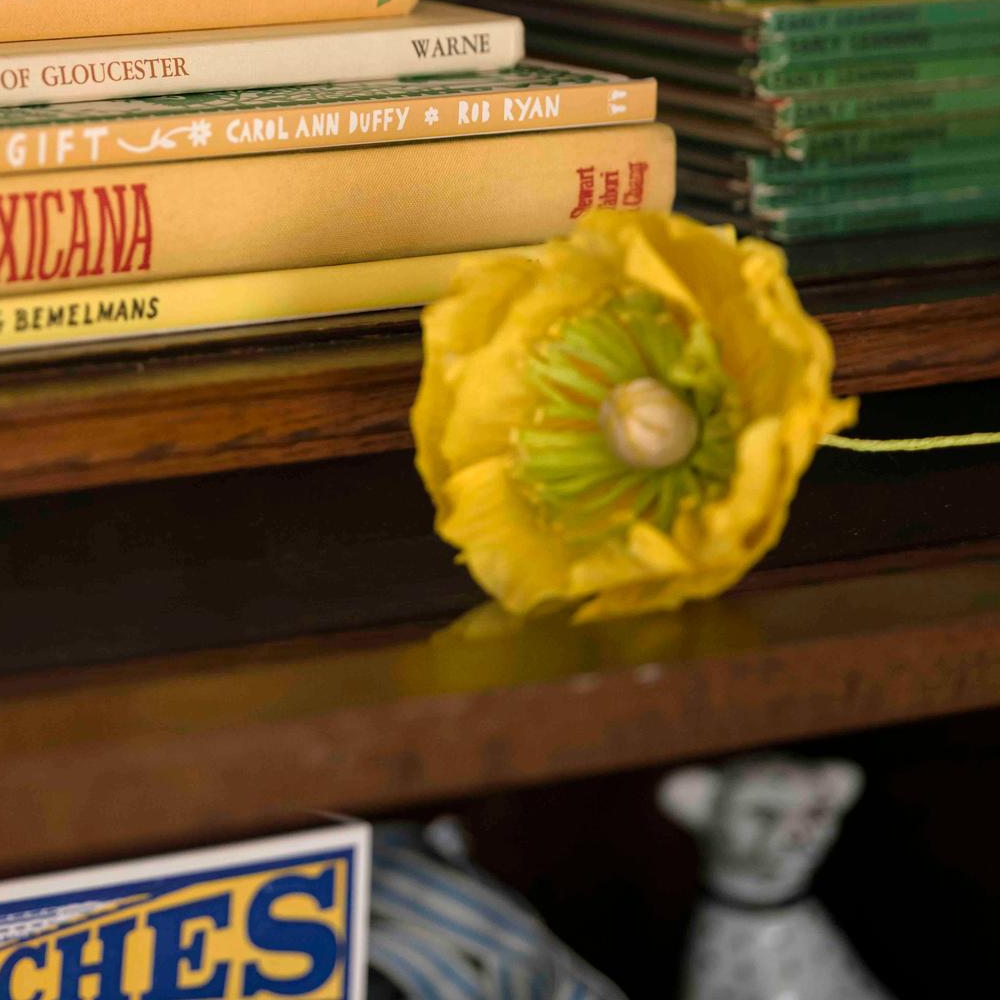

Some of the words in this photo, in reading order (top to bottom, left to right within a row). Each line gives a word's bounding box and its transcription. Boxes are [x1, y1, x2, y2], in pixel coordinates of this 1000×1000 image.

[0, 68, 31, 90] OF
[41, 56, 190, 87] GLOUCESTER
[411, 33, 491, 60] WARNE
[5, 127, 109, 167] GIFT
[226, 116, 289, 143] CAROL
[295, 112, 340, 139] ANN
[348, 106, 410, 135] DUFFY
[457, 101, 490, 125] ROB
[503, 94, 560, 122] RYAN
[15, 296, 160, 330] BEMELMANS
